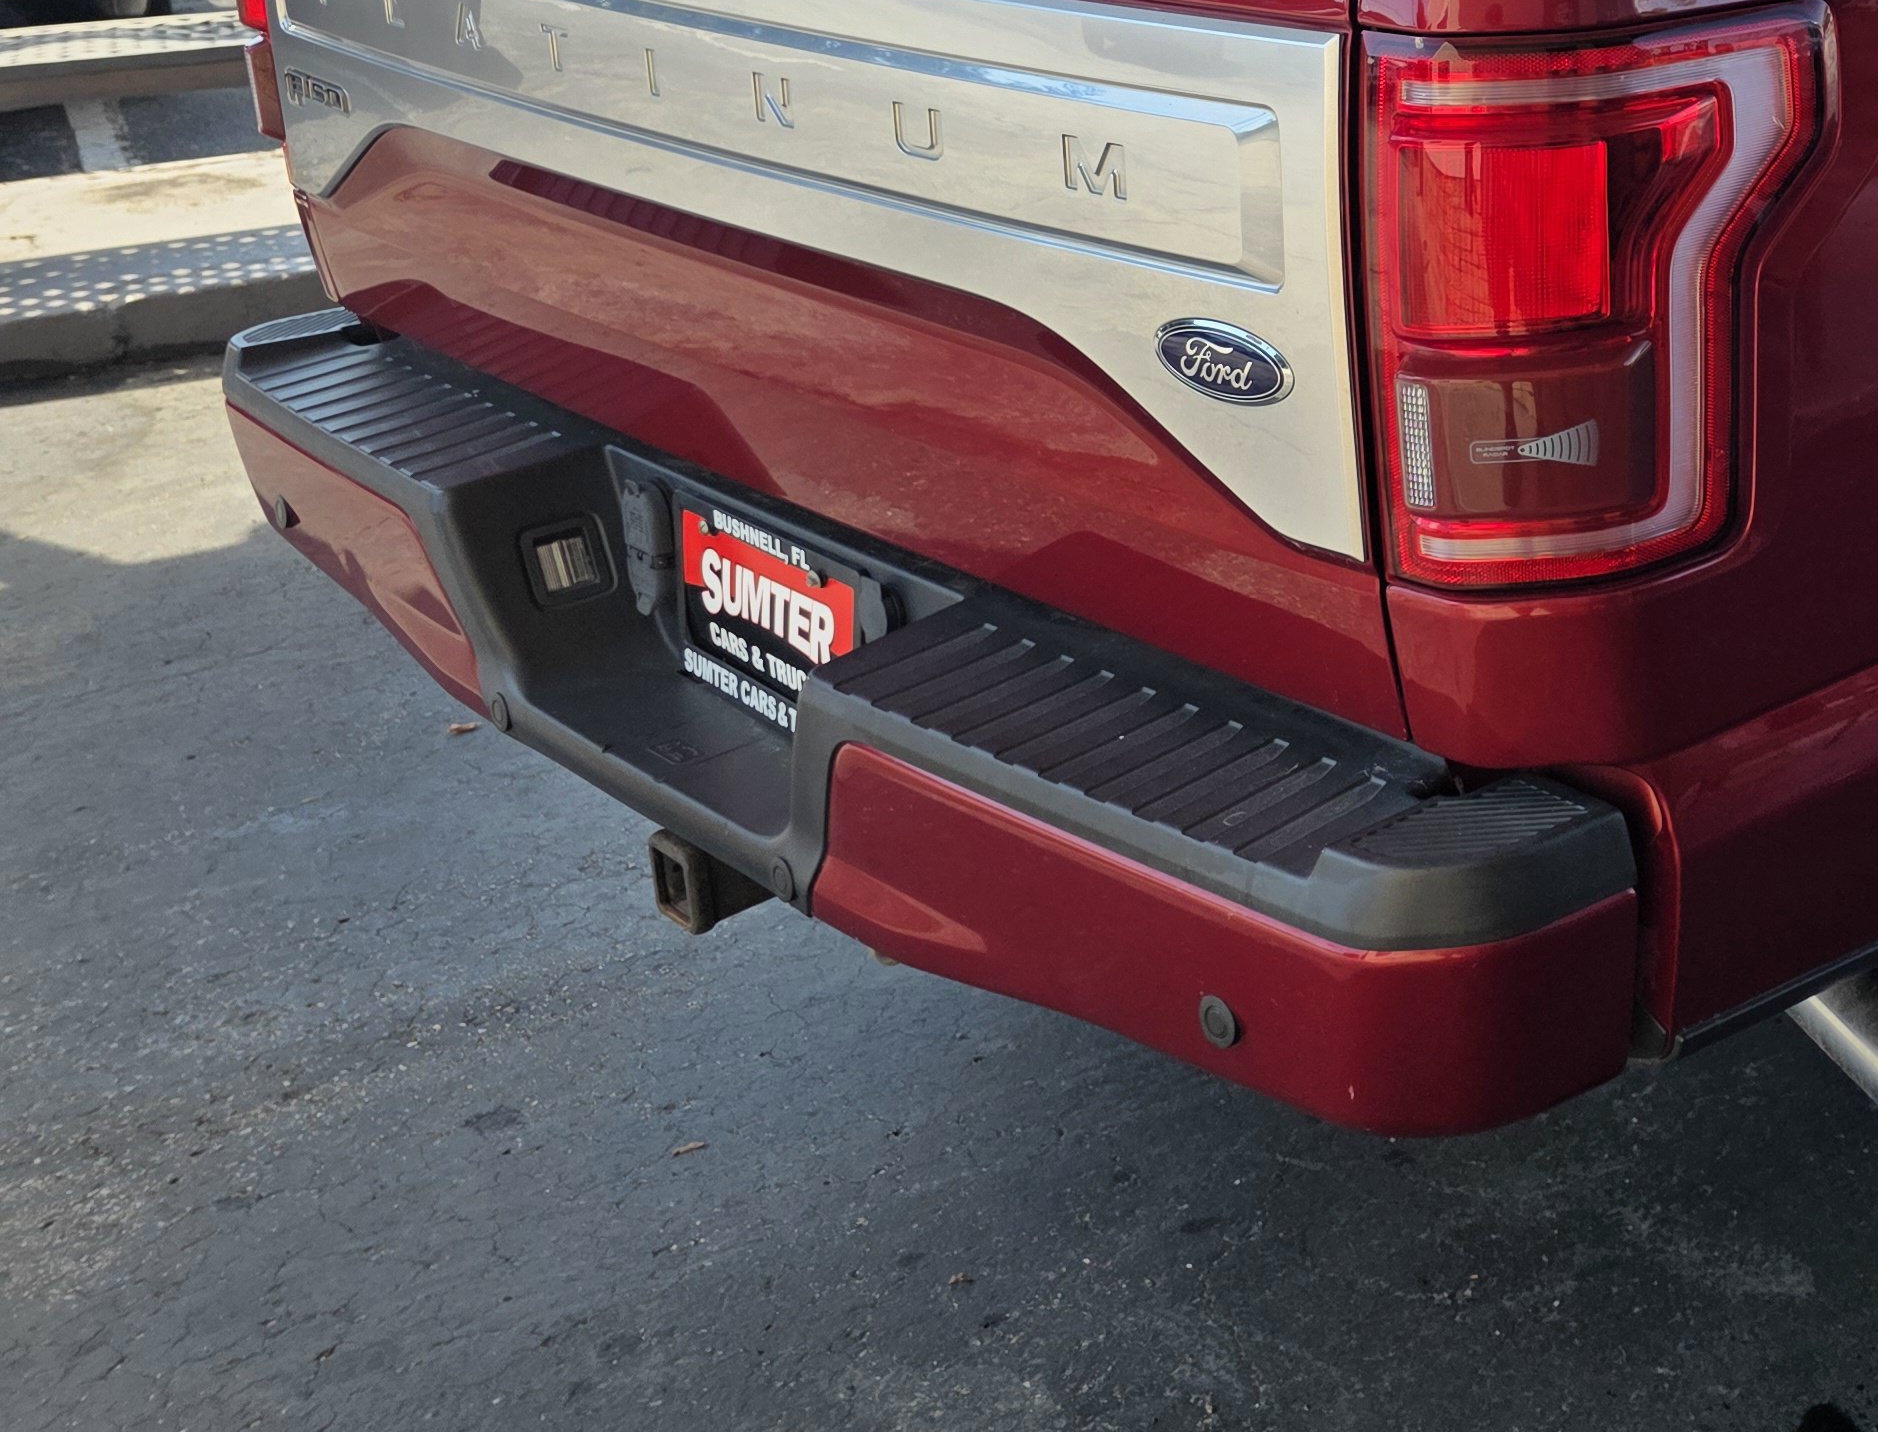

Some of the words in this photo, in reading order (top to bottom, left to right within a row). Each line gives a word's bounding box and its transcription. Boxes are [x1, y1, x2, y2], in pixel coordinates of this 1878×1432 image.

[1179, 335, 1255, 391] Ford
[713, 509, 789, 566] BUSHNELL,
[791, 544, 811, 571] FL
[700, 547, 835, 665] SUMTER
[684, 648, 739, 700] SUMTER
[740, 679, 777, 722] CARS
[777, 701, 789, 728] &
[709, 621, 749, 664] CARS
[751, 645, 766, 673] &
[766, 652, 811, 693] TRUC
